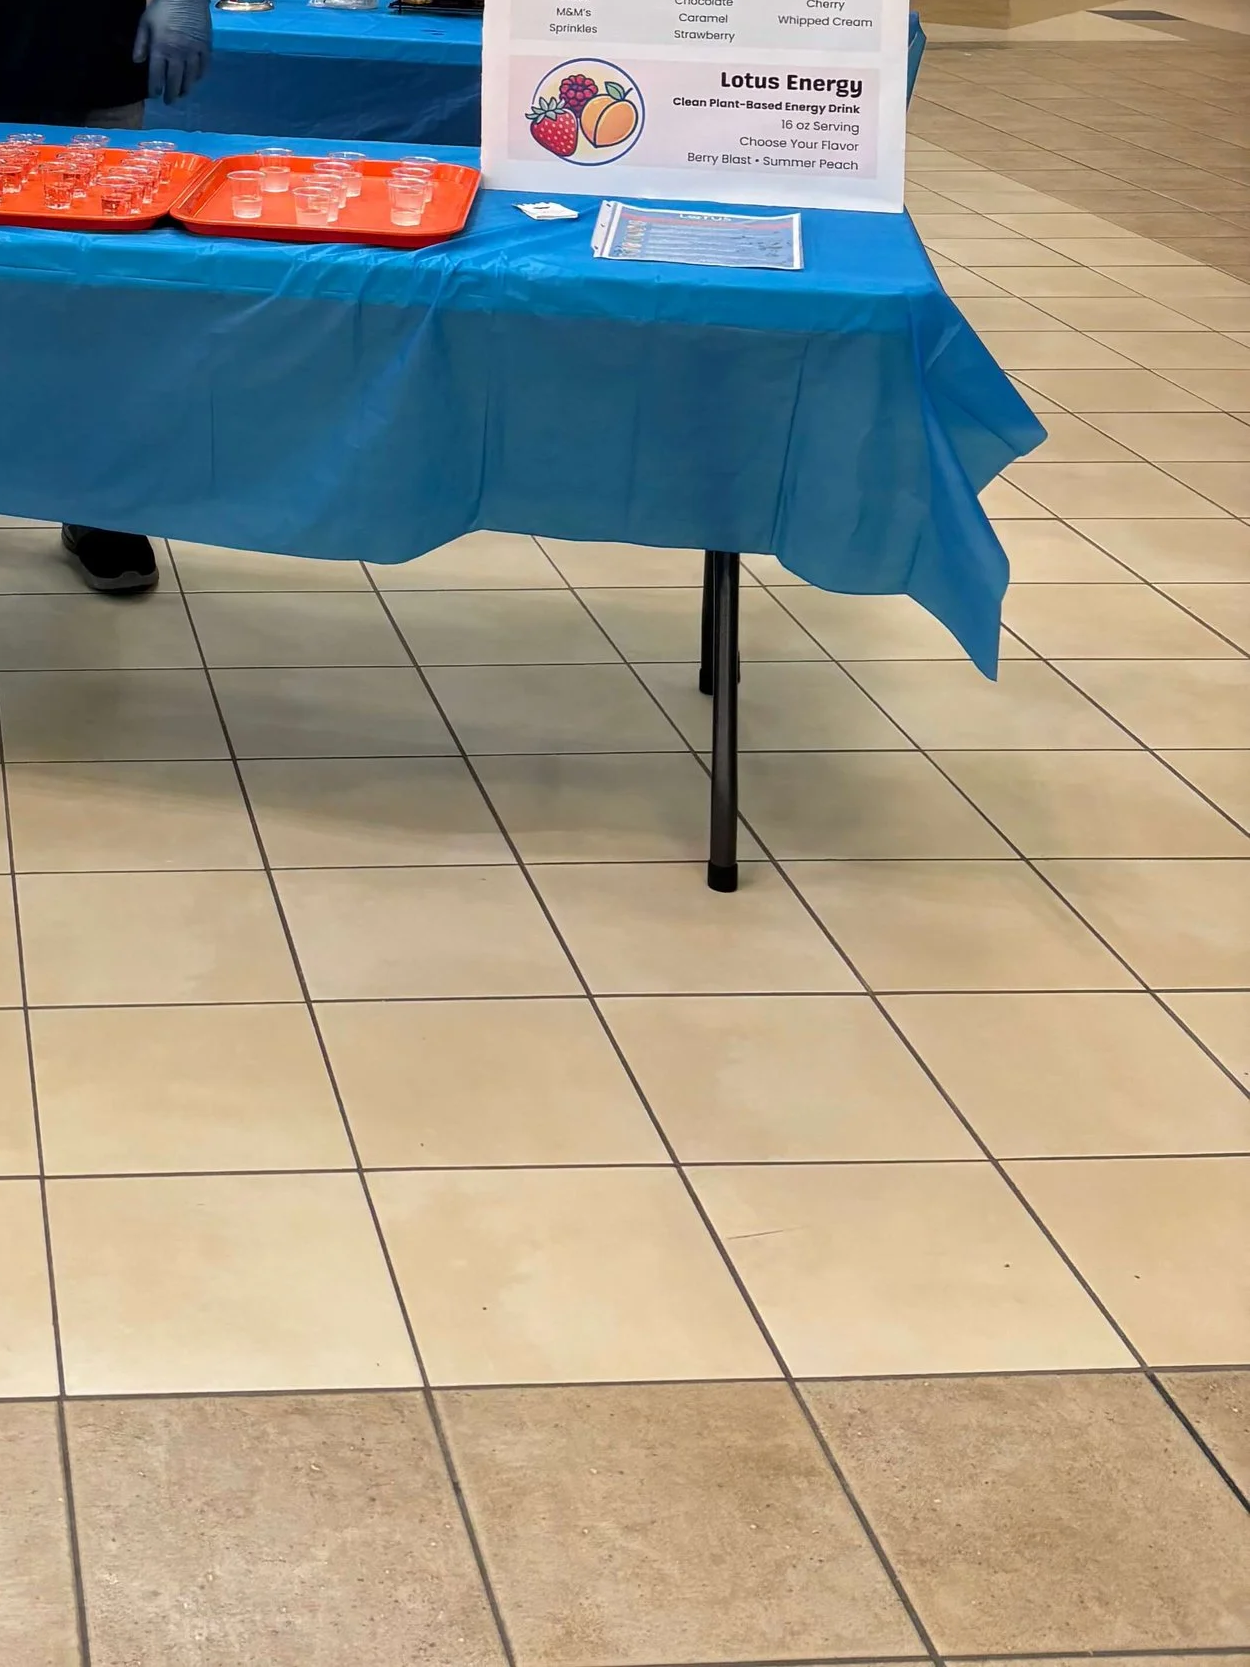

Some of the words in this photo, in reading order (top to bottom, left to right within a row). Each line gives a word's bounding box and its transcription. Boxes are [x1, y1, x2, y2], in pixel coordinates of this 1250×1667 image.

[557, 8, 591, 16] M&M's
[807, 0, 845, 11] Cherry
[679, 13, 727, 23] Caramel
[778, 16, 829, 27] Whipped
[833, 17, 872, 27] Cream
[550, 24, 597, 34] Sprinkles
[675, 30, 735, 43] Strawberry
[722, 72, 779, 89] Lotus
[787, 75, 862, 98] Energy
[673, 97, 706, 106] Clean
[710, 99, 782, 110] Plant-Based
[785, 102, 826, 115] Energy
[829, 104, 860, 113] Drink
[782, 120, 793, 129] 16
[796, 122, 810, 130] oz
[814, 121, 859, 135] Serving
[740, 137, 787, 147] Choose
[791, 139, 818, 149] Your
[822, 141, 859, 151] Flavor
[688, 153, 718, 165] Berry
[722, 154, 751, 164] Blast
[763, 157, 816, 167] Summer
[820, 159, 858, 170] Peach
